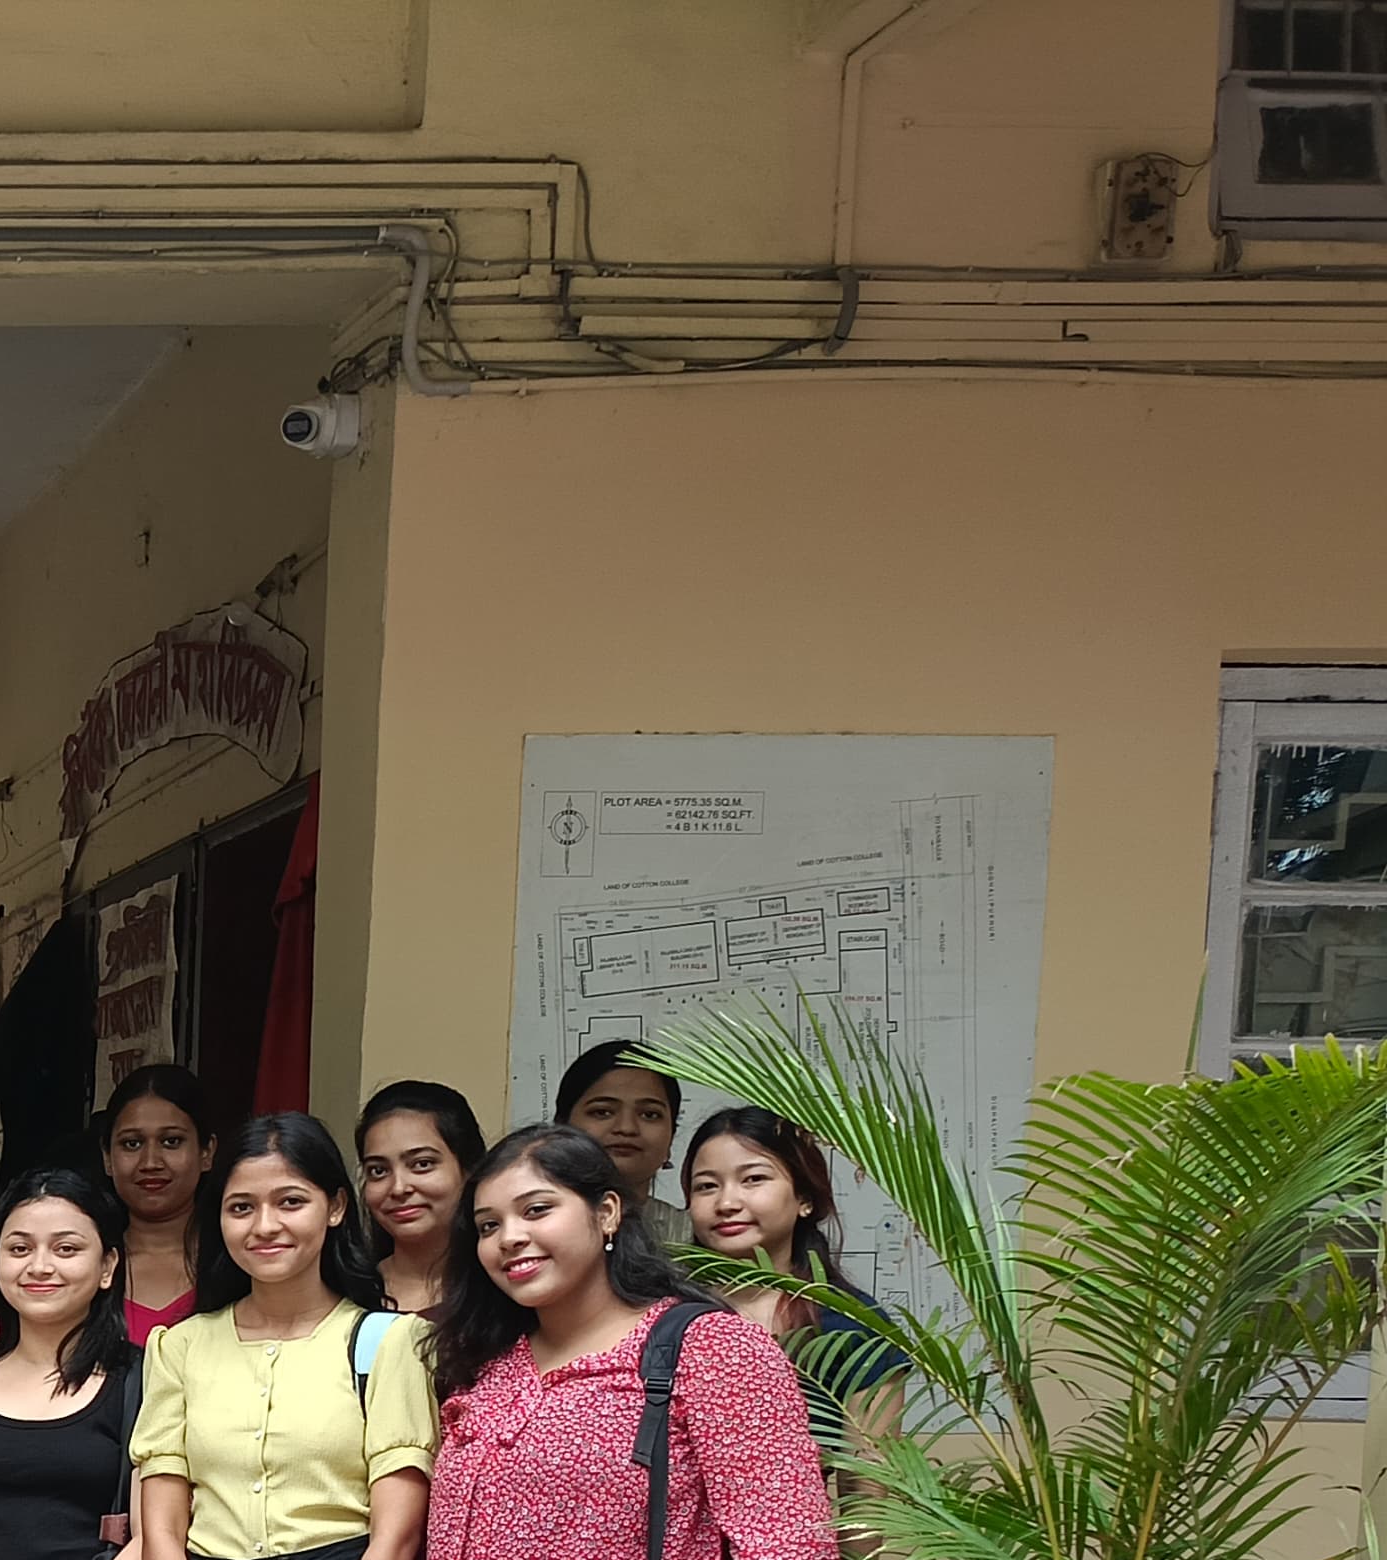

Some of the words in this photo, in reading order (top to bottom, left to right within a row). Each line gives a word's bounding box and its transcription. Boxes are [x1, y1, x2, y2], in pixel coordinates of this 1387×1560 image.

[603, 797, 631, 807] PLOT
[633, 797, 663, 807] AREA
[673, 797, 712, 807] 5775.35
[701, 822, 709, 831] K
